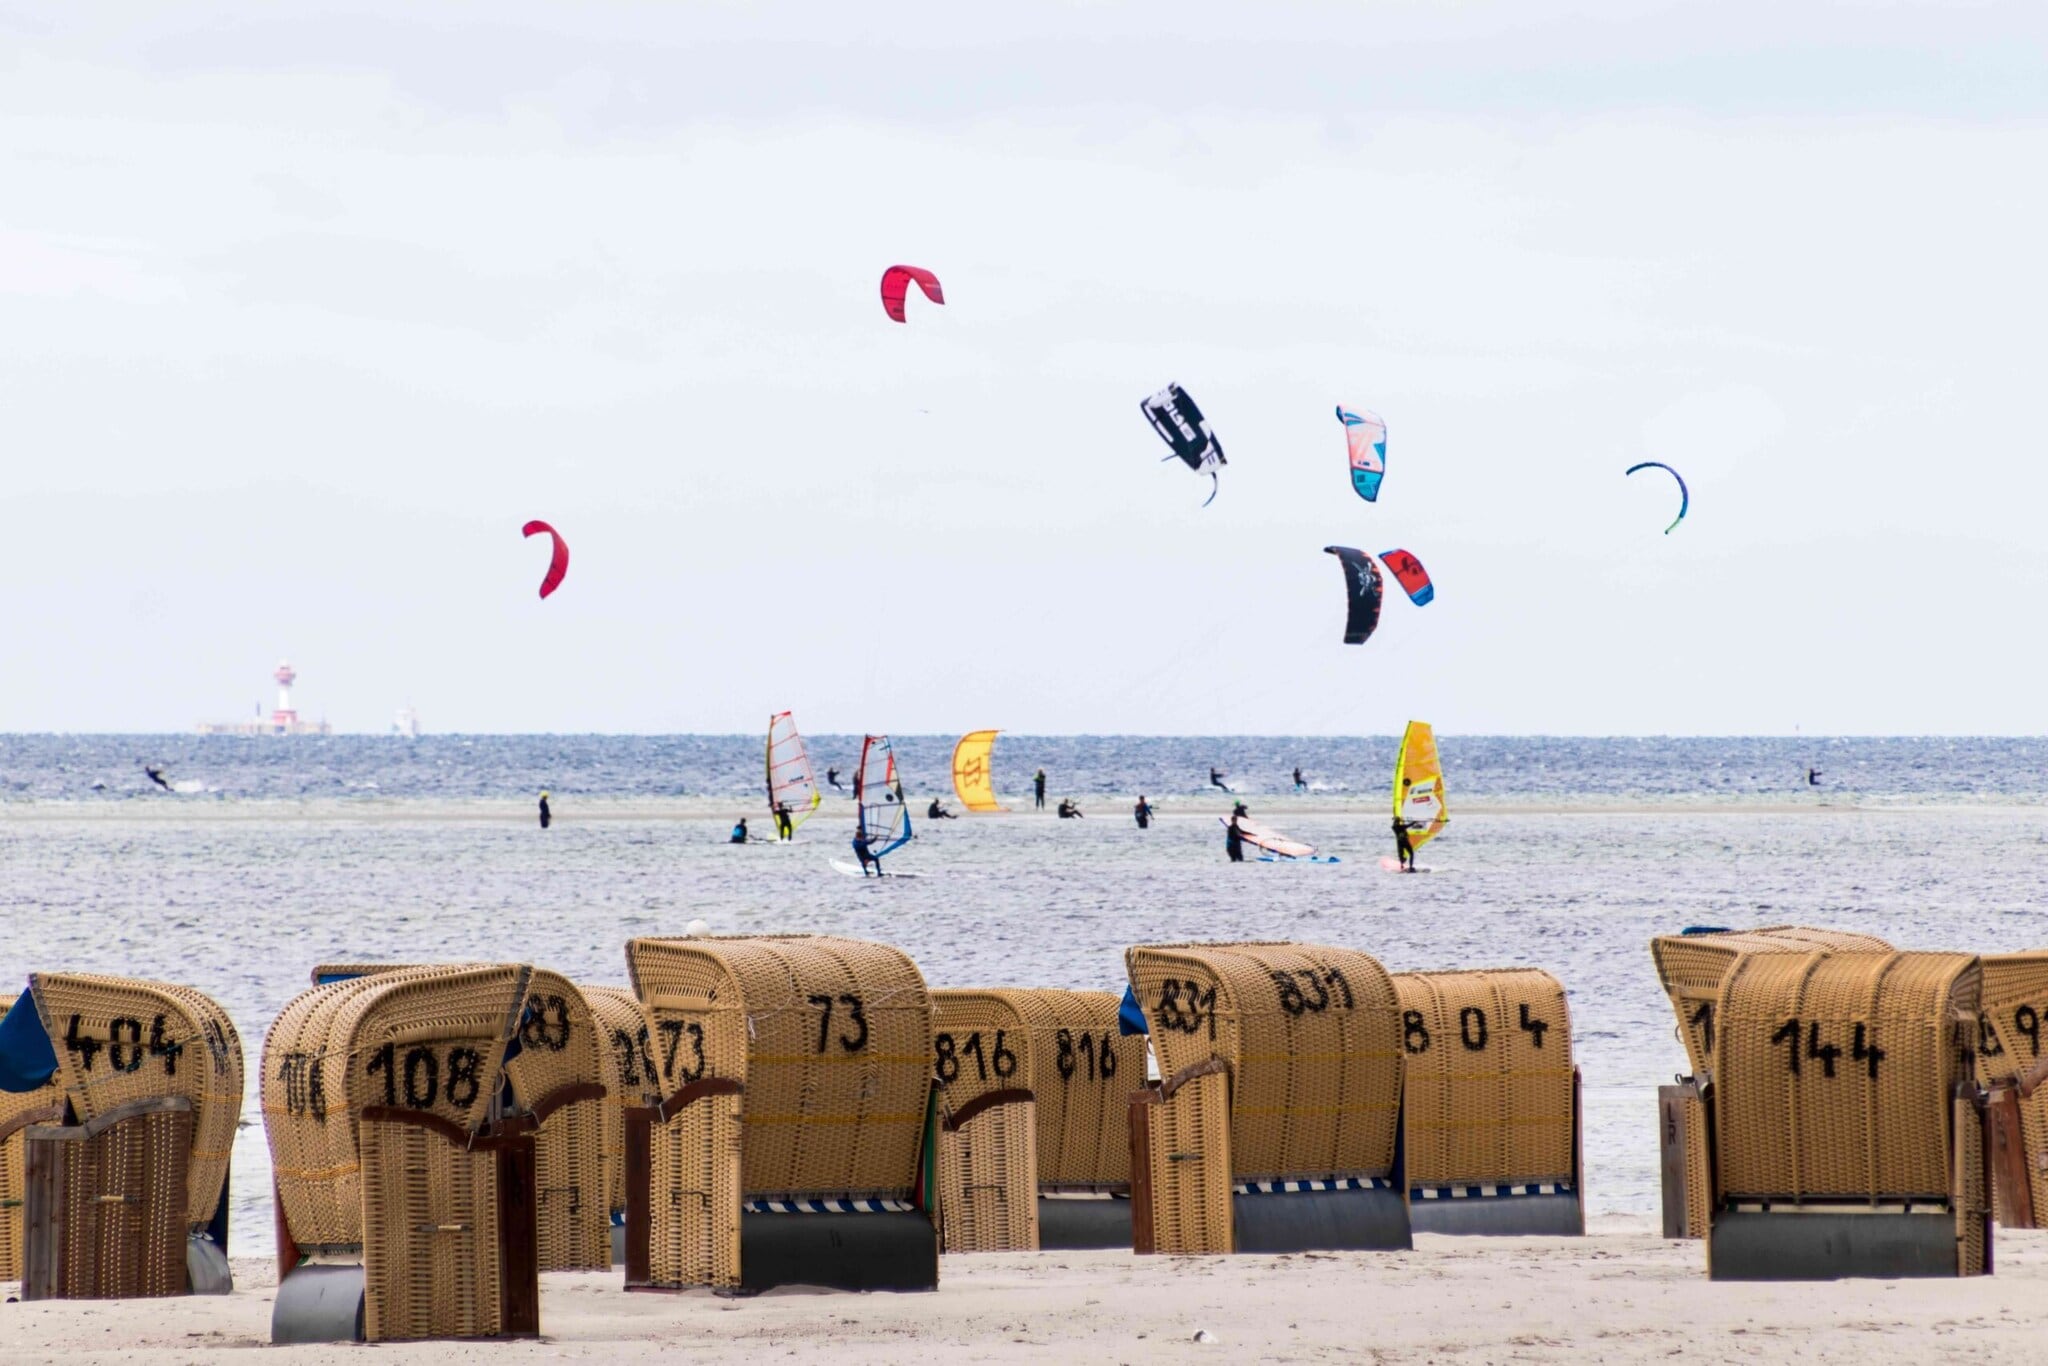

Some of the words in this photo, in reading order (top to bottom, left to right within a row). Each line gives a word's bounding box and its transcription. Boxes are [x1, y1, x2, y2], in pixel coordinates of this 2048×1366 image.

[1160, 978, 1217, 1041] 831
[1270, 967, 1355, 1016] 831
[65, 1013, 183, 1075] 404
[660, 1019, 705, 1082] 73
[808, 993, 869, 1053] 73
[1403, 1002, 1548, 1054] 804
[1771, 1017, 1886, 1079] 144
[366, 1042, 481, 1109] 108
[934, 1029, 1017, 1084] 816
[1056, 1028, 1117, 1082] 816
